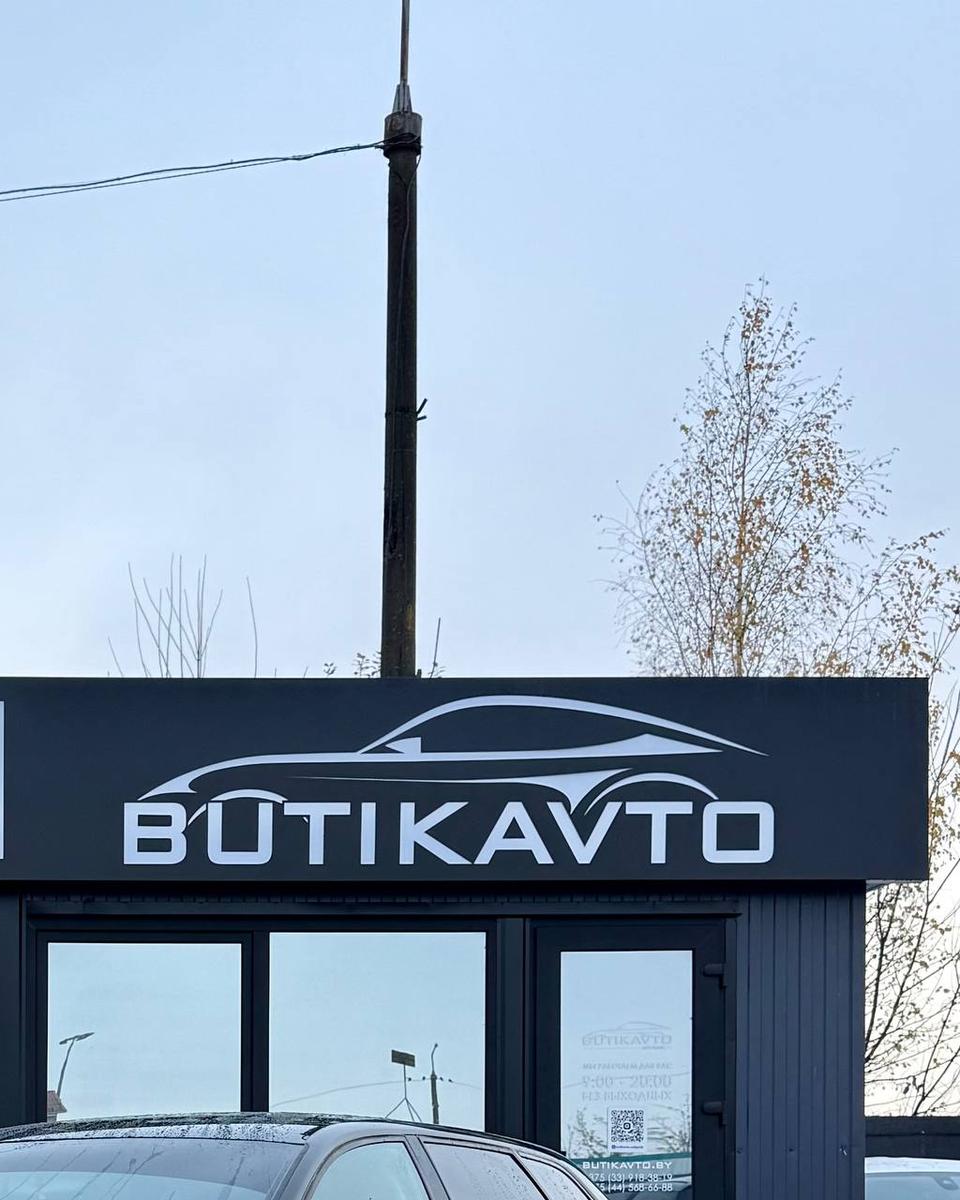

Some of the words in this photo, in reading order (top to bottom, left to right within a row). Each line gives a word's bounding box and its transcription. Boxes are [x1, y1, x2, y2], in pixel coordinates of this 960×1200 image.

[123, 799, 774, 865] BUTIKAVTO
[582, 1161, 672, 1169] BUTIKAVTO.BY
[607, 1173, 625, 1184] (33)
[607, 1182, 625, 1193] (44)
[628, 1183, 672, 1192] 568-66-88
